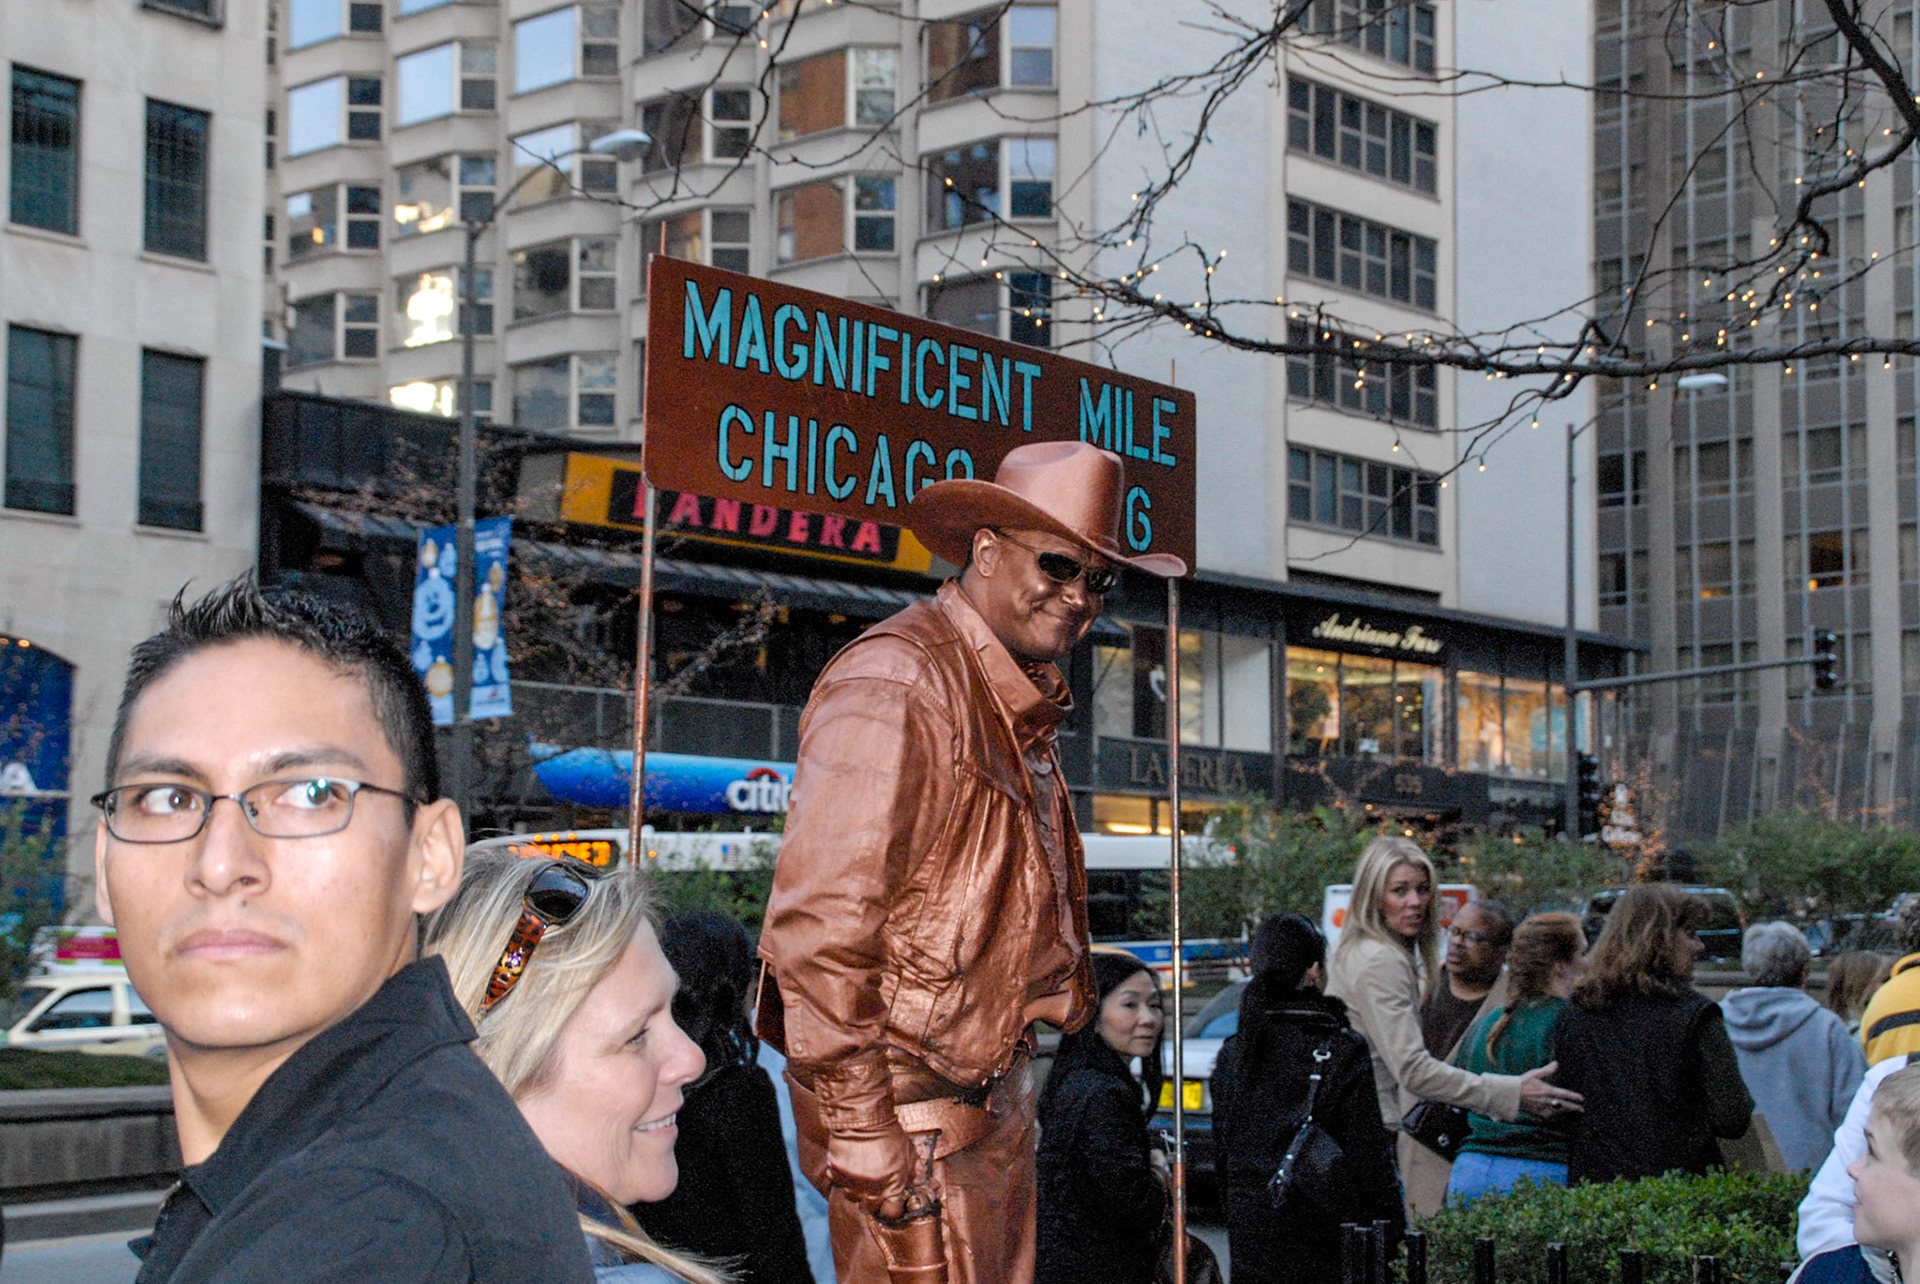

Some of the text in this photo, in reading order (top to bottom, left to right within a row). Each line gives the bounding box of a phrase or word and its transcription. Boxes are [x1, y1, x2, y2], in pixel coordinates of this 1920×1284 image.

[683, 278, 1177, 468] MAGNIFICENT MILE
[1168, 752, 1249, 793] ERLA
